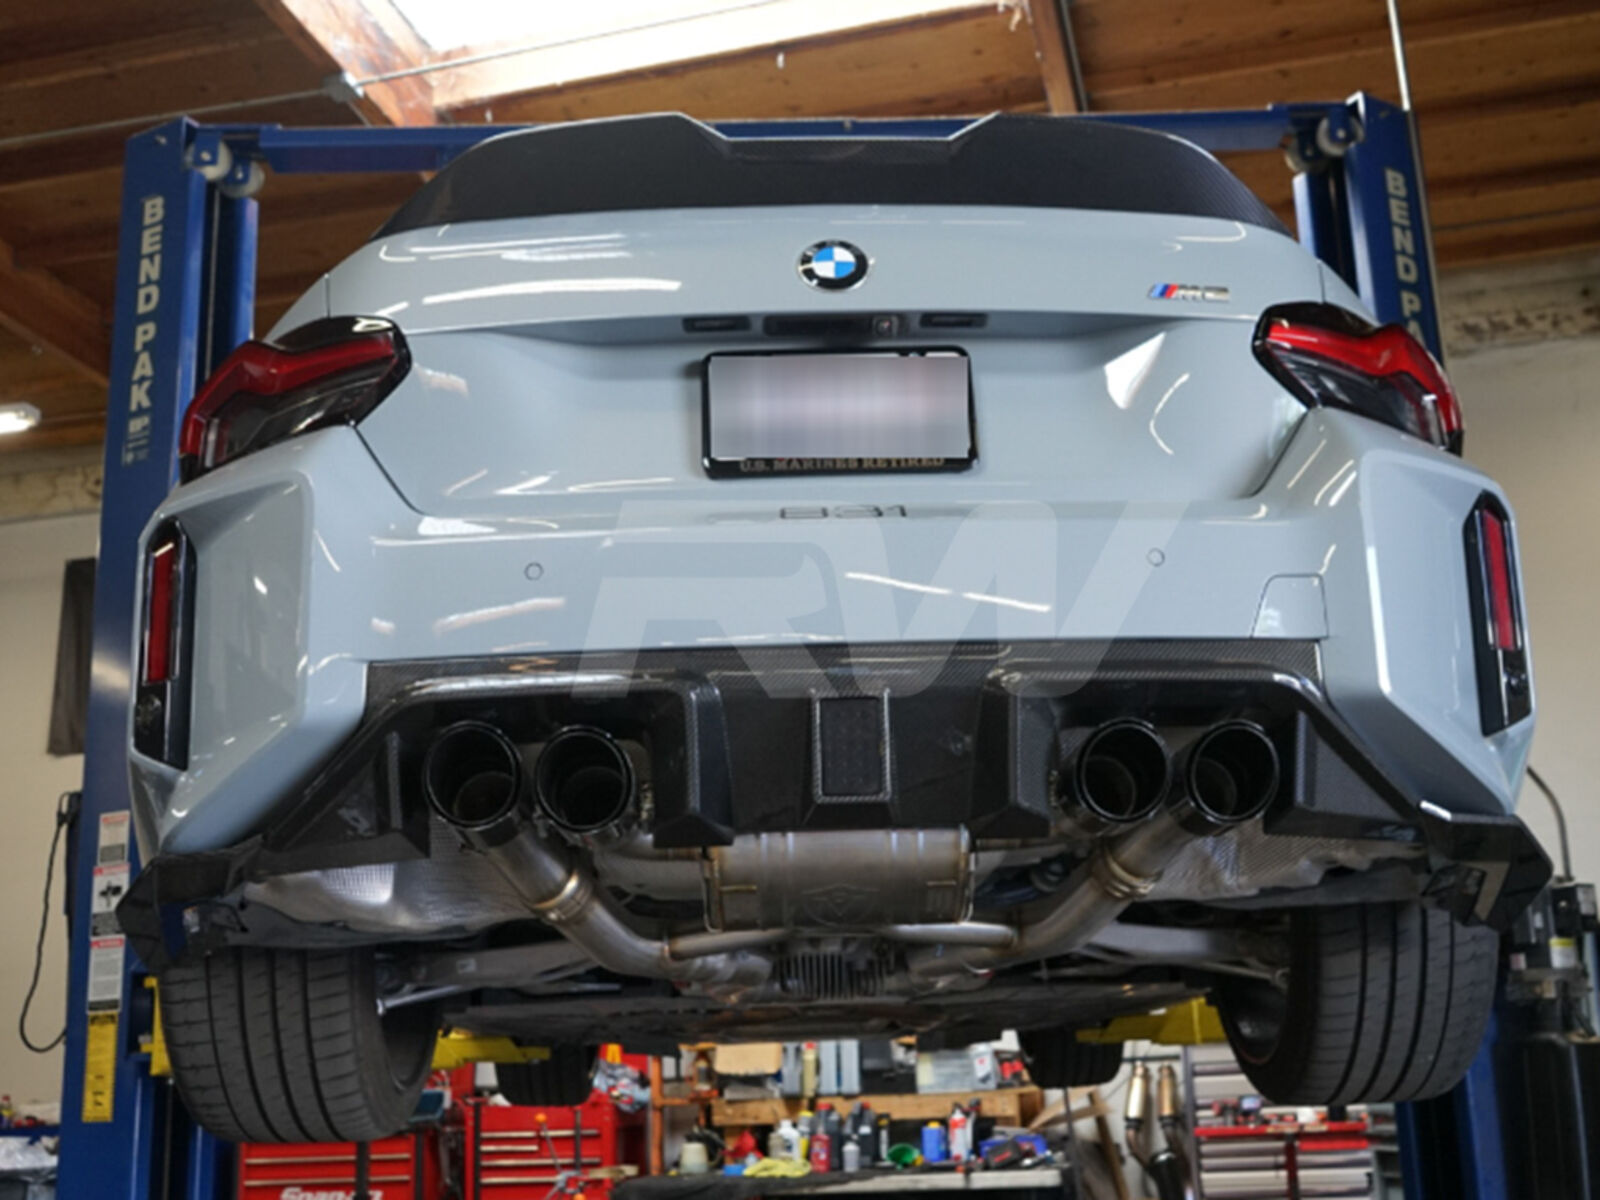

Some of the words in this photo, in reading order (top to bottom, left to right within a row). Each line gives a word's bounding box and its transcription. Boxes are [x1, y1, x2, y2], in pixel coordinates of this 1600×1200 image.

[136, 196, 165, 315] BEND
[1385, 168, 1419, 284] BEND
[1400, 290, 1427, 348] PA
[129, 322, 155, 412] PAK
[773, 457, 855, 471] MARINES
[862, 456, 945, 469] RETIRED
